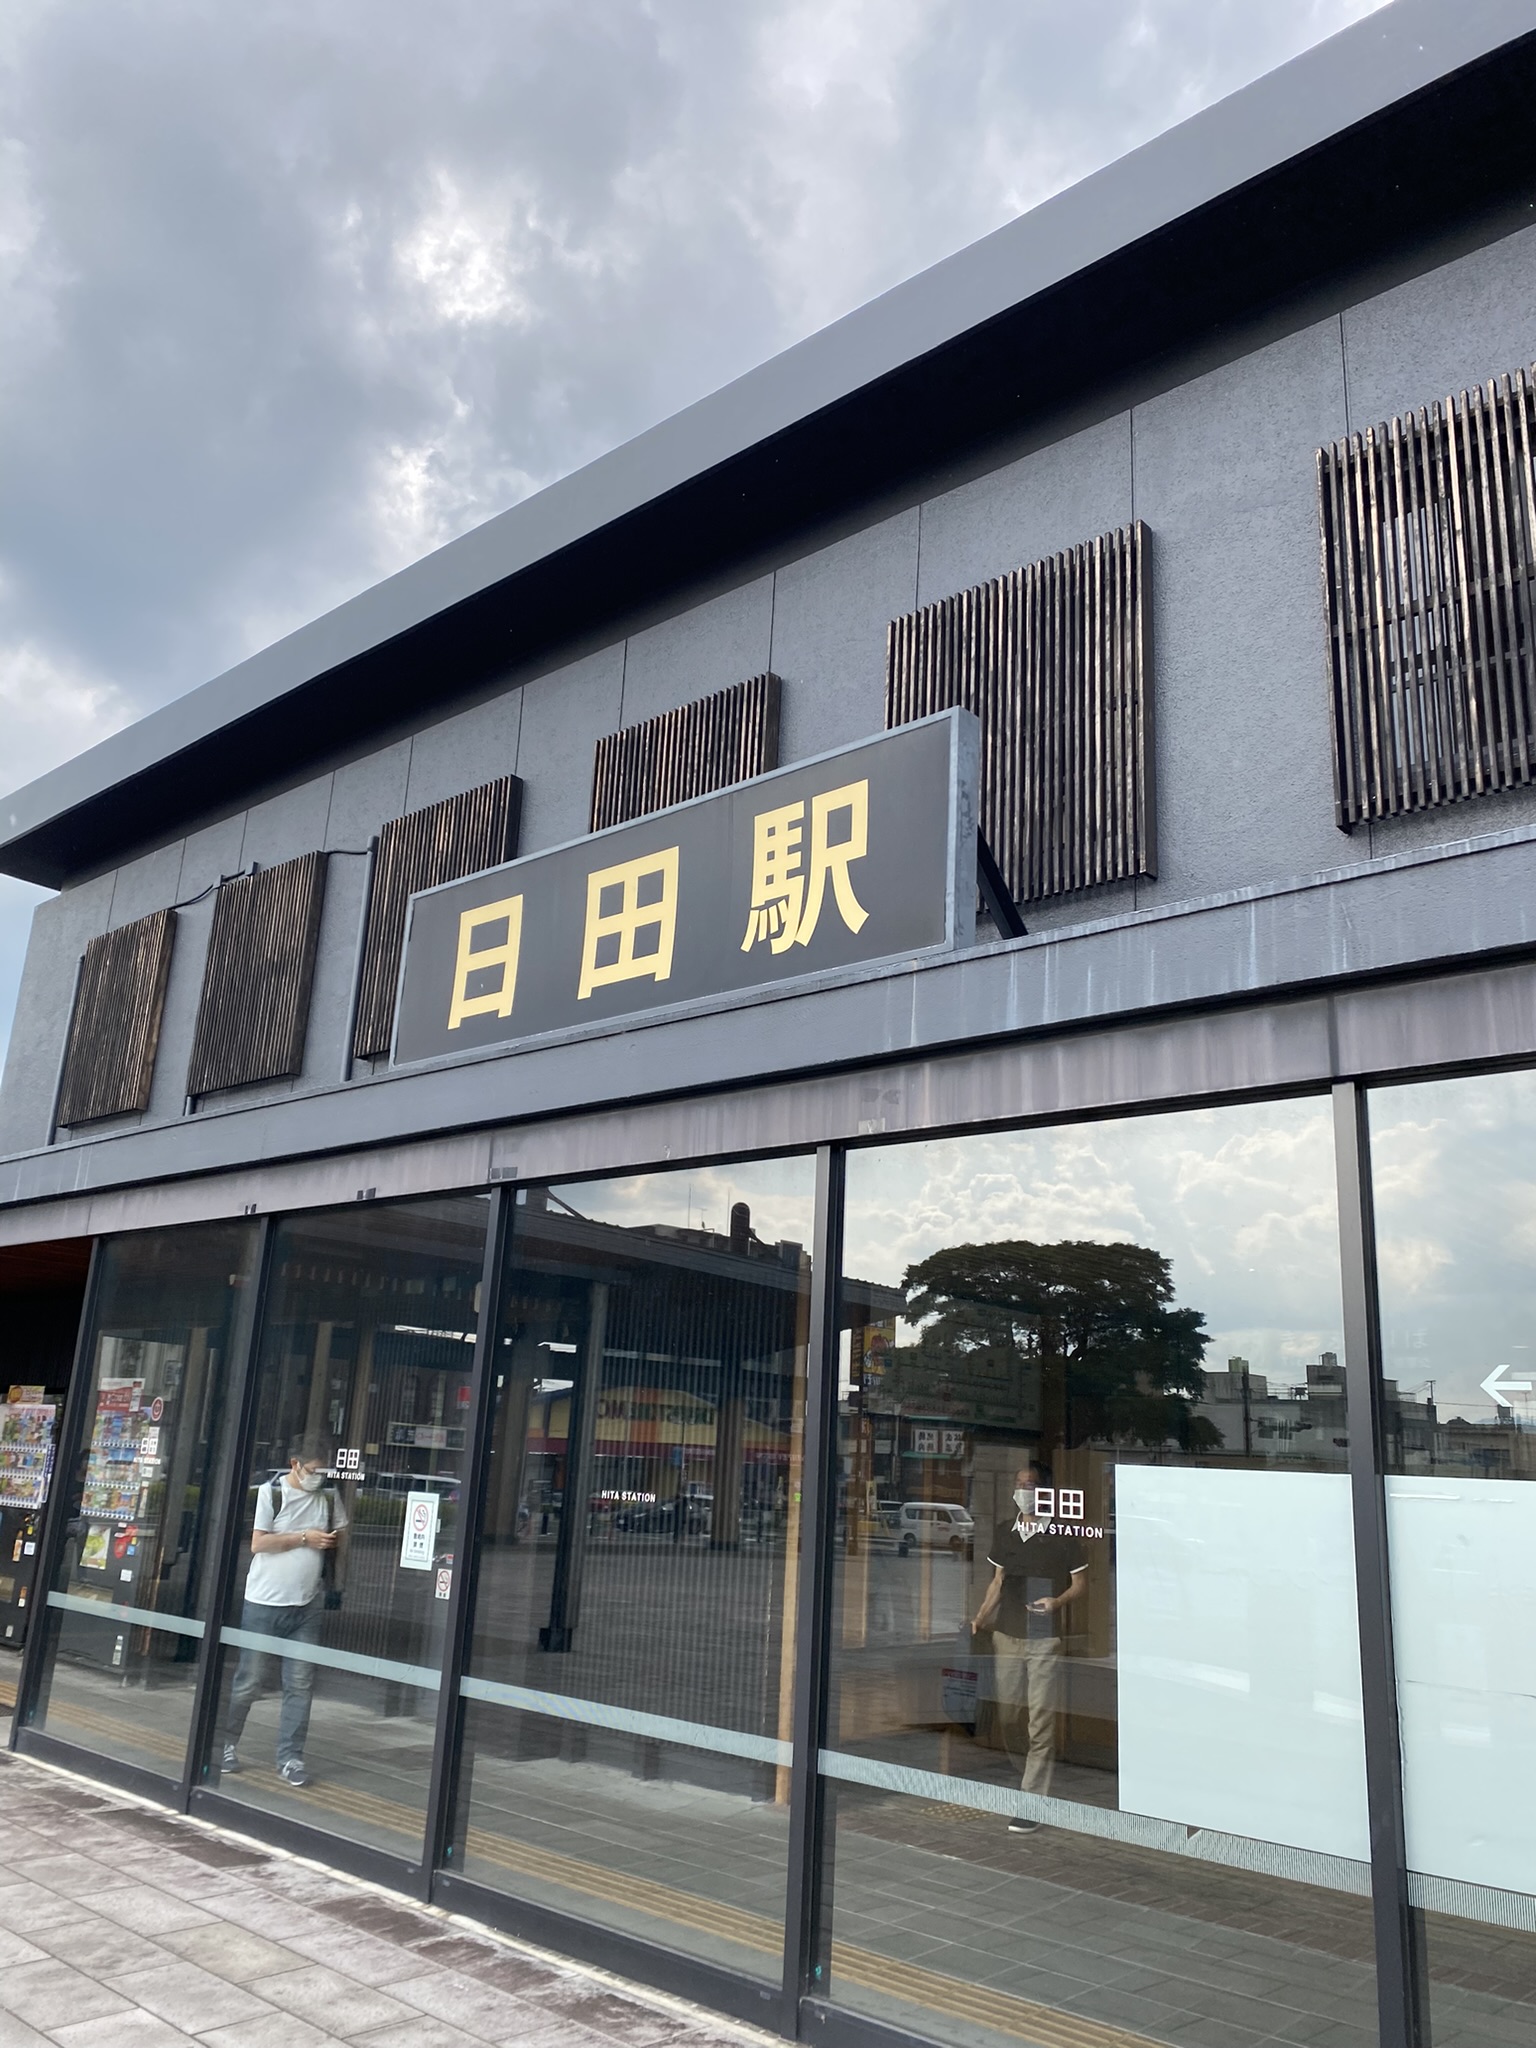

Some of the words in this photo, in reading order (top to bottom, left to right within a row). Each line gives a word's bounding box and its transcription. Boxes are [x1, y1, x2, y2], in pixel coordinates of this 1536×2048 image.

[447, 778, 870, 1031] 日田駅
[336, 1449, 360, 1468] 日田
[341, 1473, 365, 1482] STATION
[601, 1491, 620, 1500] HITA
[622, 1491, 656, 1503] STATION
[1034, 1487, 1084, 1519] 日田
[1017, 1521, 1044, 1533] HITA
[1049, 1523, 1103, 1539] STATION
